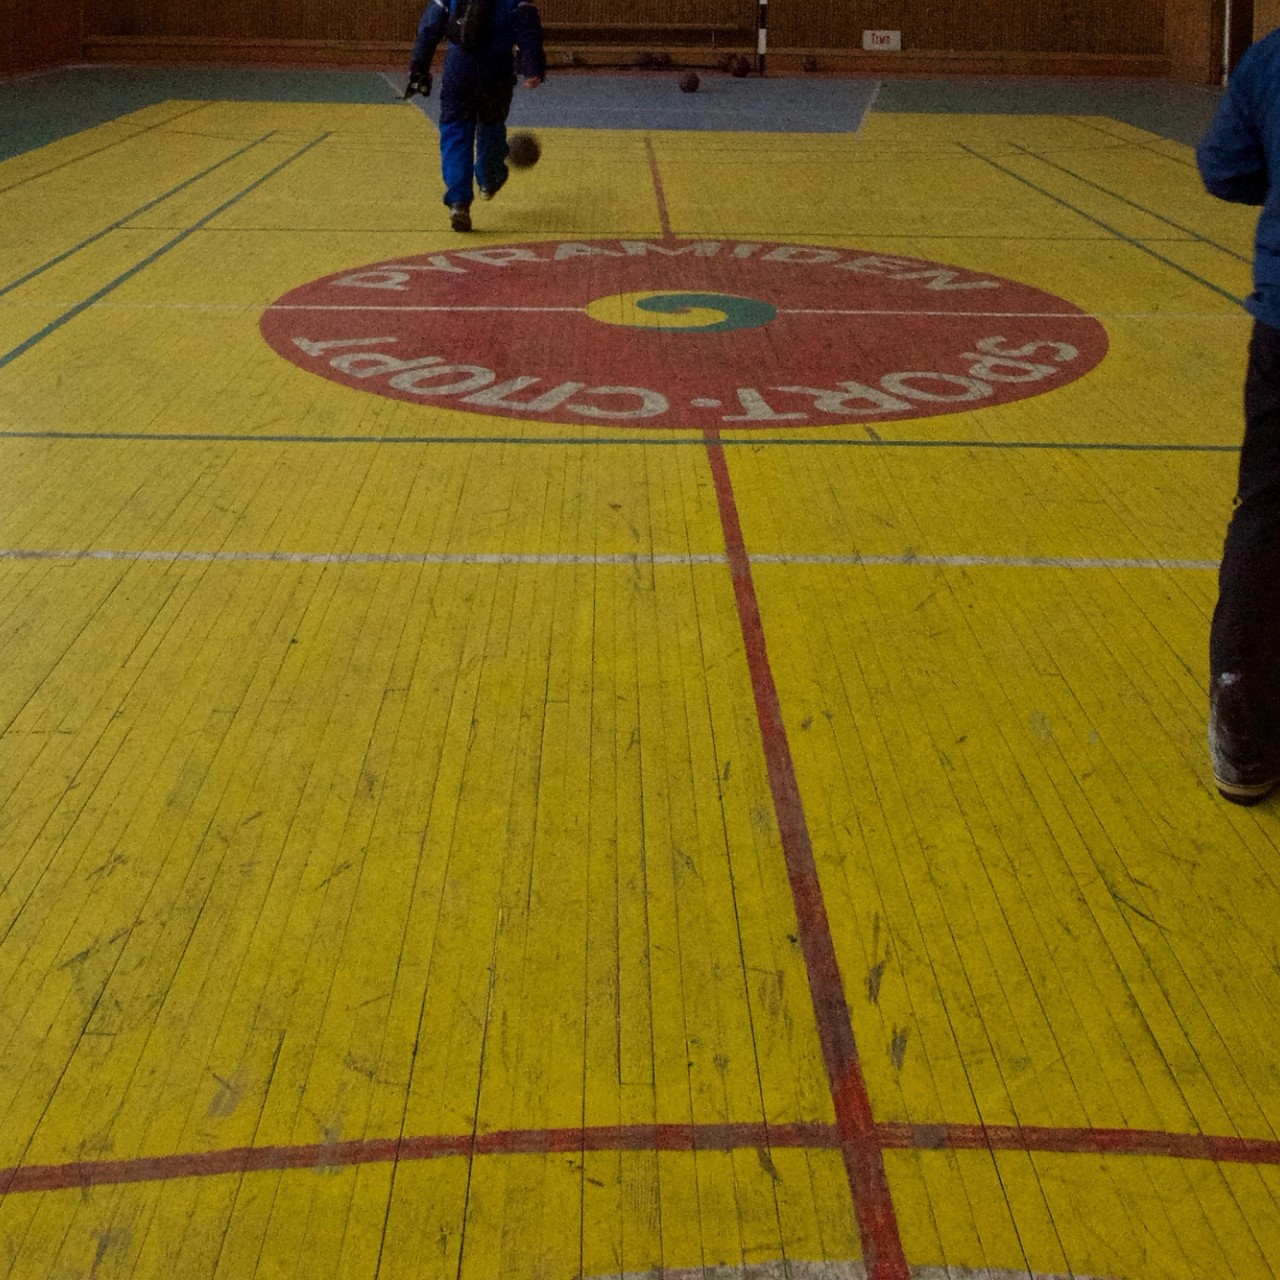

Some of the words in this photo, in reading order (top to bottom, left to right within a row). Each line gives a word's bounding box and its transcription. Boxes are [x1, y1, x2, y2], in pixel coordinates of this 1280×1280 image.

[331, 240, 1001, 293] PYRAMIDEN
[291, 336, 669, 418] СПОРТ
[722, 334, 1081, 422] SPORT
